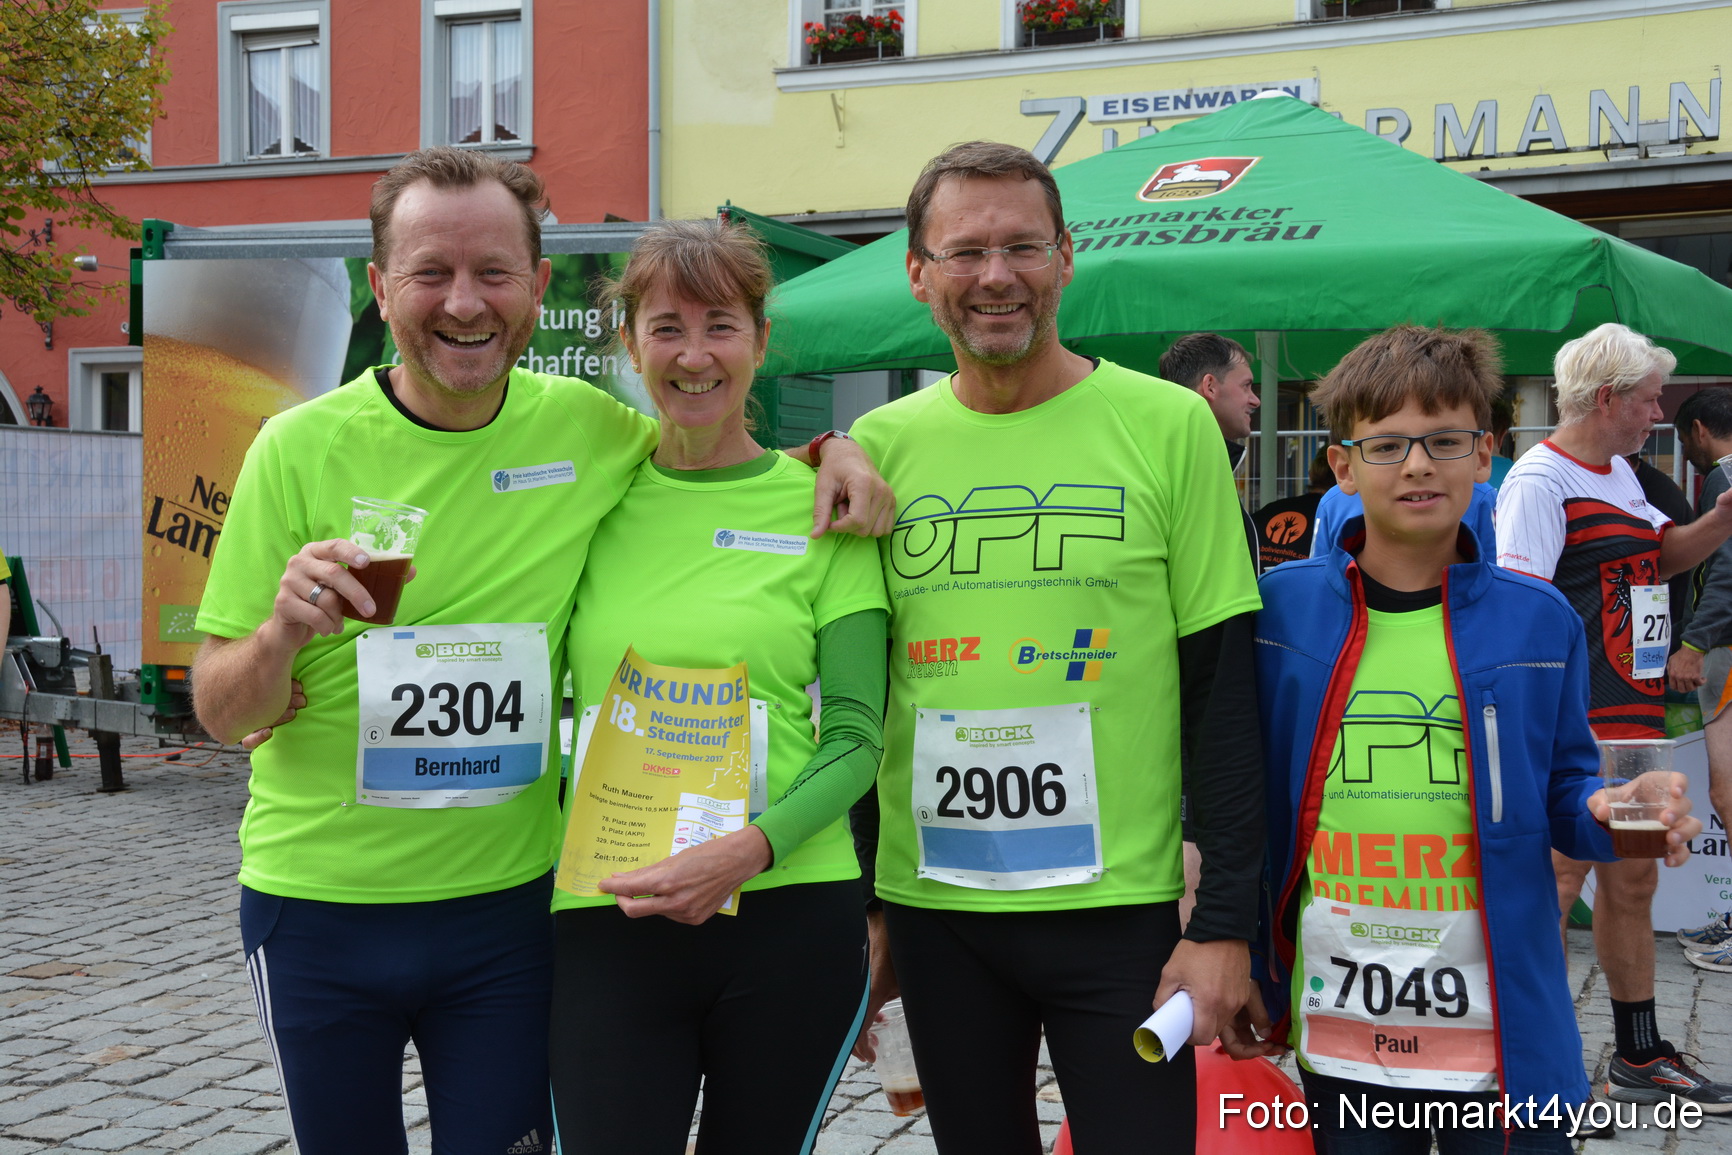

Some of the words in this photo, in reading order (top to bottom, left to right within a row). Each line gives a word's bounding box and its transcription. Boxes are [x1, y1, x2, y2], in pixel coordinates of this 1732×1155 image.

[1103, 85, 1300, 116] EISENWARN
[1158, 189, 1202, 198] 1628
[1065, 206, 1294, 233] eumarkter
[189, 475, 231, 516] Ne
[893, 585, 928, 600] Gebäude-
[932, 581, 949, 592] und
[952, 577, 1081, 590] Automatisierungstechnik
[1085, 577, 1118, 589] GmbH
[436, 641, 502, 657] BOCK
[907, 636, 981, 665] MERZ
[1017, 646, 1117, 665] Bretschneider
[907, 658, 958, 679] Reisen
[619, 658, 744, 706] URKUNDE
[390, 680, 525, 737] 2304
[609, 694, 644, 737] 18.
[650, 710, 744, 730] Neumarkter
[370, 730, 377, 740] C
[647, 726, 730, 749] Stadtlauf
[970, 724, 1034, 742] BOCK
[645, 747, 655, 755] 17.
[657, 749, 703, 762] September
[705, 755, 724, 763] 2017
[415, 755, 500, 776] Bernhard
[642, 763, 671, 775] DKMS
[589, 792, 608, 804] belegte
[602, 783, 620, 795] Ruth
[621, 789, 653, 801] Mauerer
[936, 762, 1067, 820] 2906
[1329, 789, 1345, 799] und
[612, 818, 627, 826] Platz
[921, 810, 928, 819] D
[608, 827, 623, 836] Platz
[610, 839, 625, 847] Platz
[1371, 924, 1441, 944] BOCK
[1330, 955, 1469, 1018] 7049
[1308, 996, 1320, 1008] B6
[1375, 1033, 1418, 1054] Paul
[507, 1143, 544, 1155] adidas
